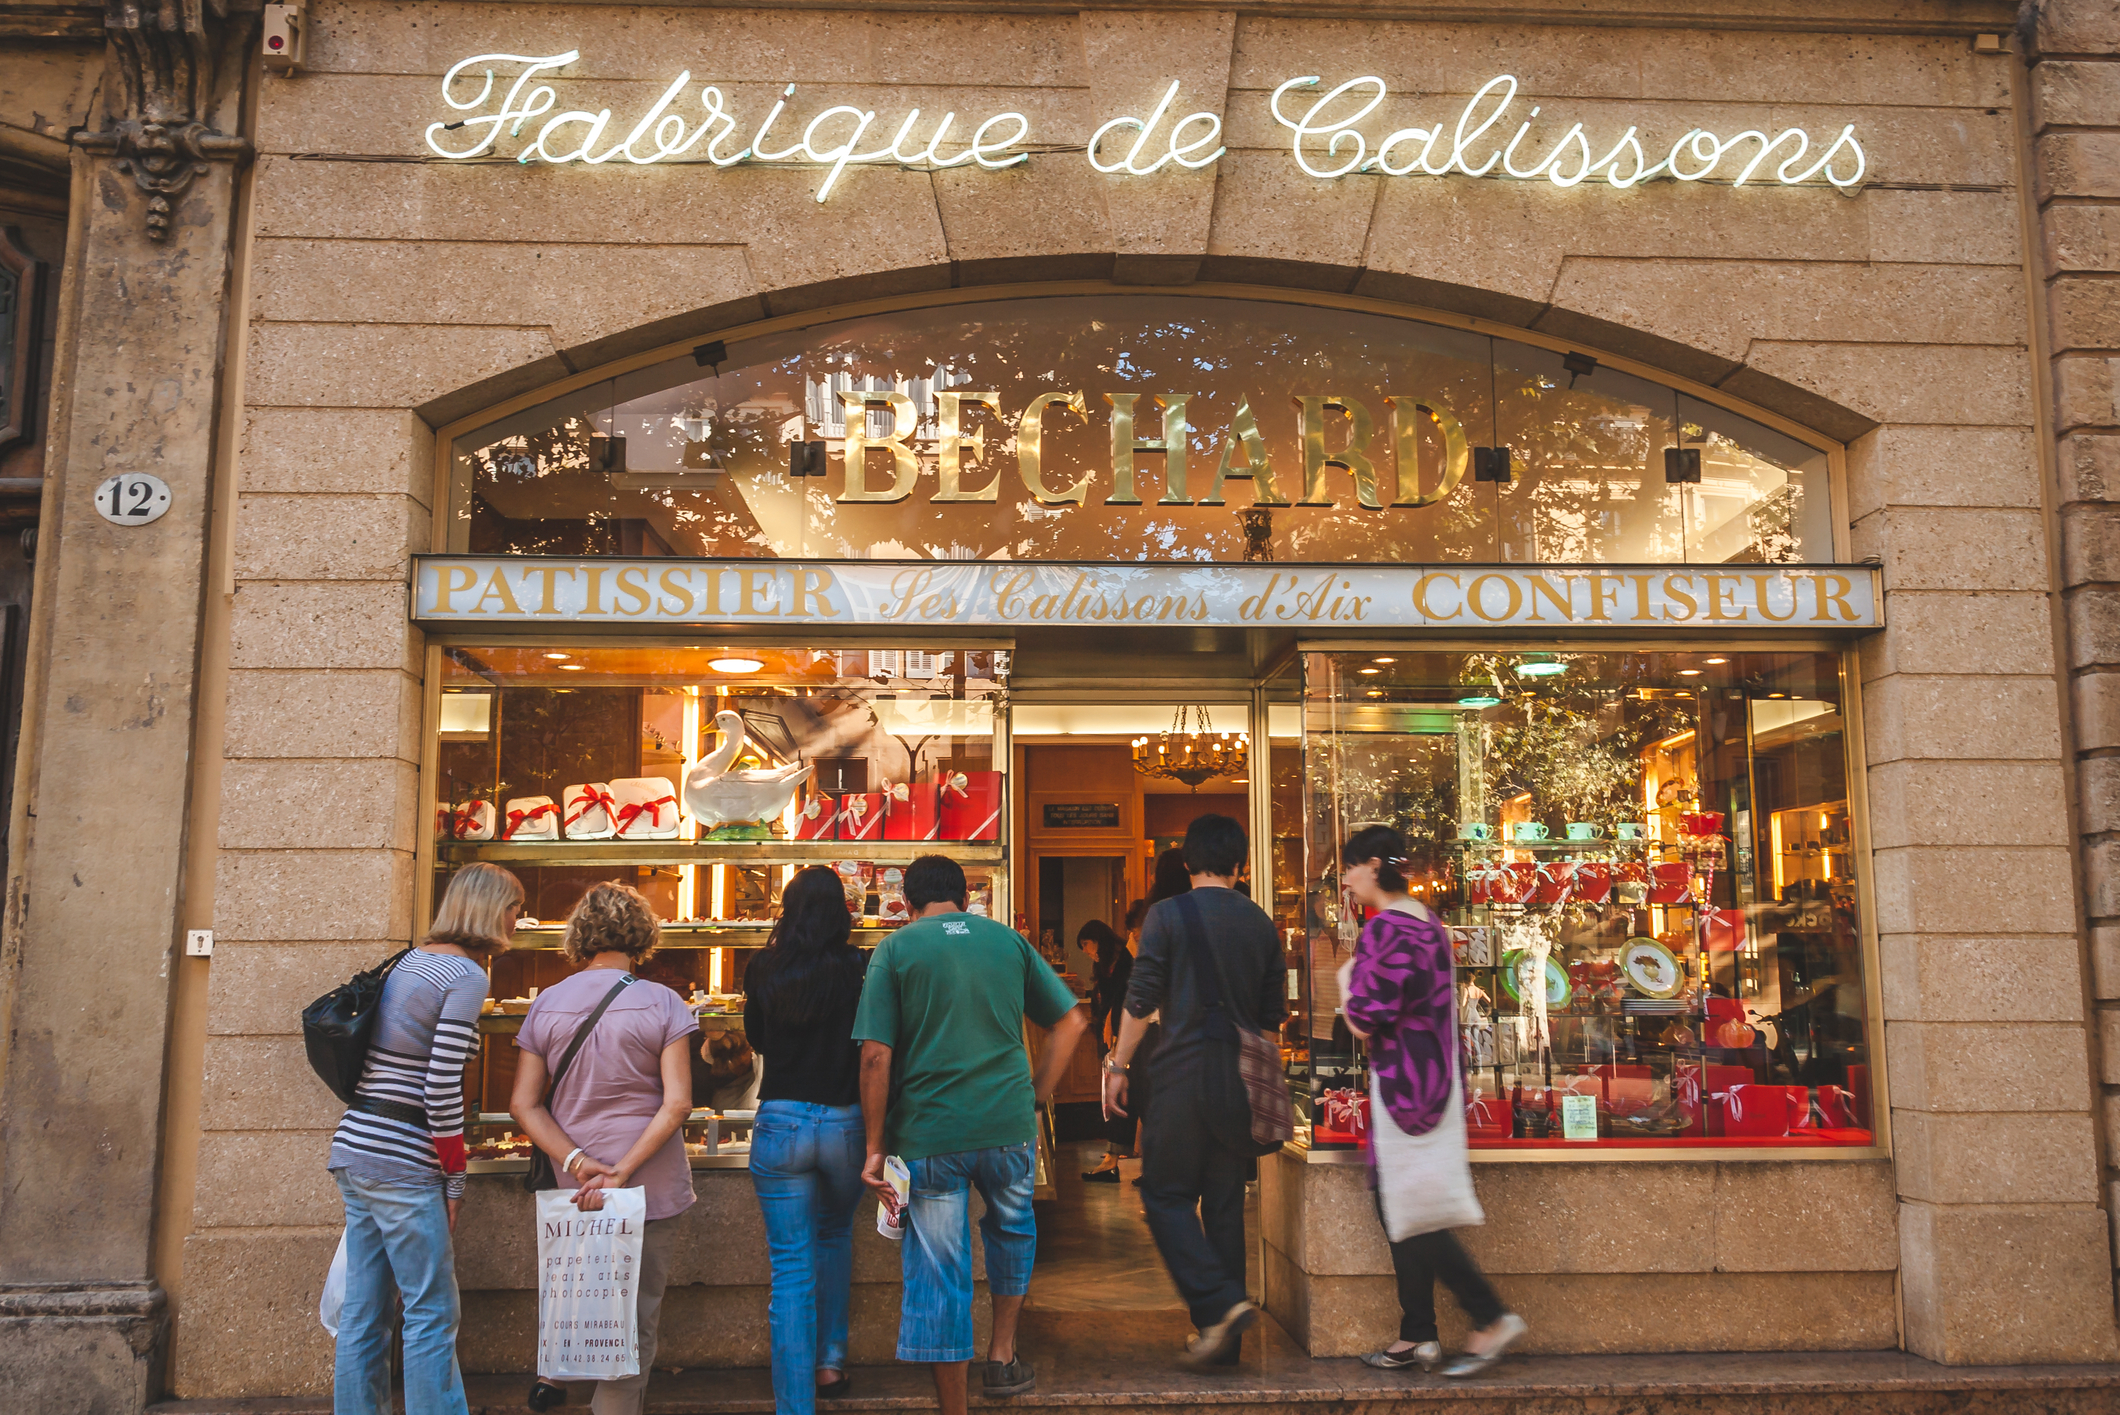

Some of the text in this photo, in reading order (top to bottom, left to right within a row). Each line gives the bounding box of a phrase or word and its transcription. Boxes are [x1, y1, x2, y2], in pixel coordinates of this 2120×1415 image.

[425, 49, 1865, 204] Fabrique de Calissons
[836, 389, 1468, 510] BECHARD
[108, 481, 153, 517] 12
[427, 564, 1862, 623] PATISSIER Les Calissons d'Aix CONFISEUR
[544, 1218, 633, 1239] MICHEL
[546, 1252, 632, 1269] papeterie
[598, 1269, 630, 1282] arts
[542, 1286, 629, 1300] photocopie
[554, 1320, 579, 1330] COURS
[584, 1319, 625, 1330] MIRABEAU
[584, 1338, 625, 1348] PROVENCE
